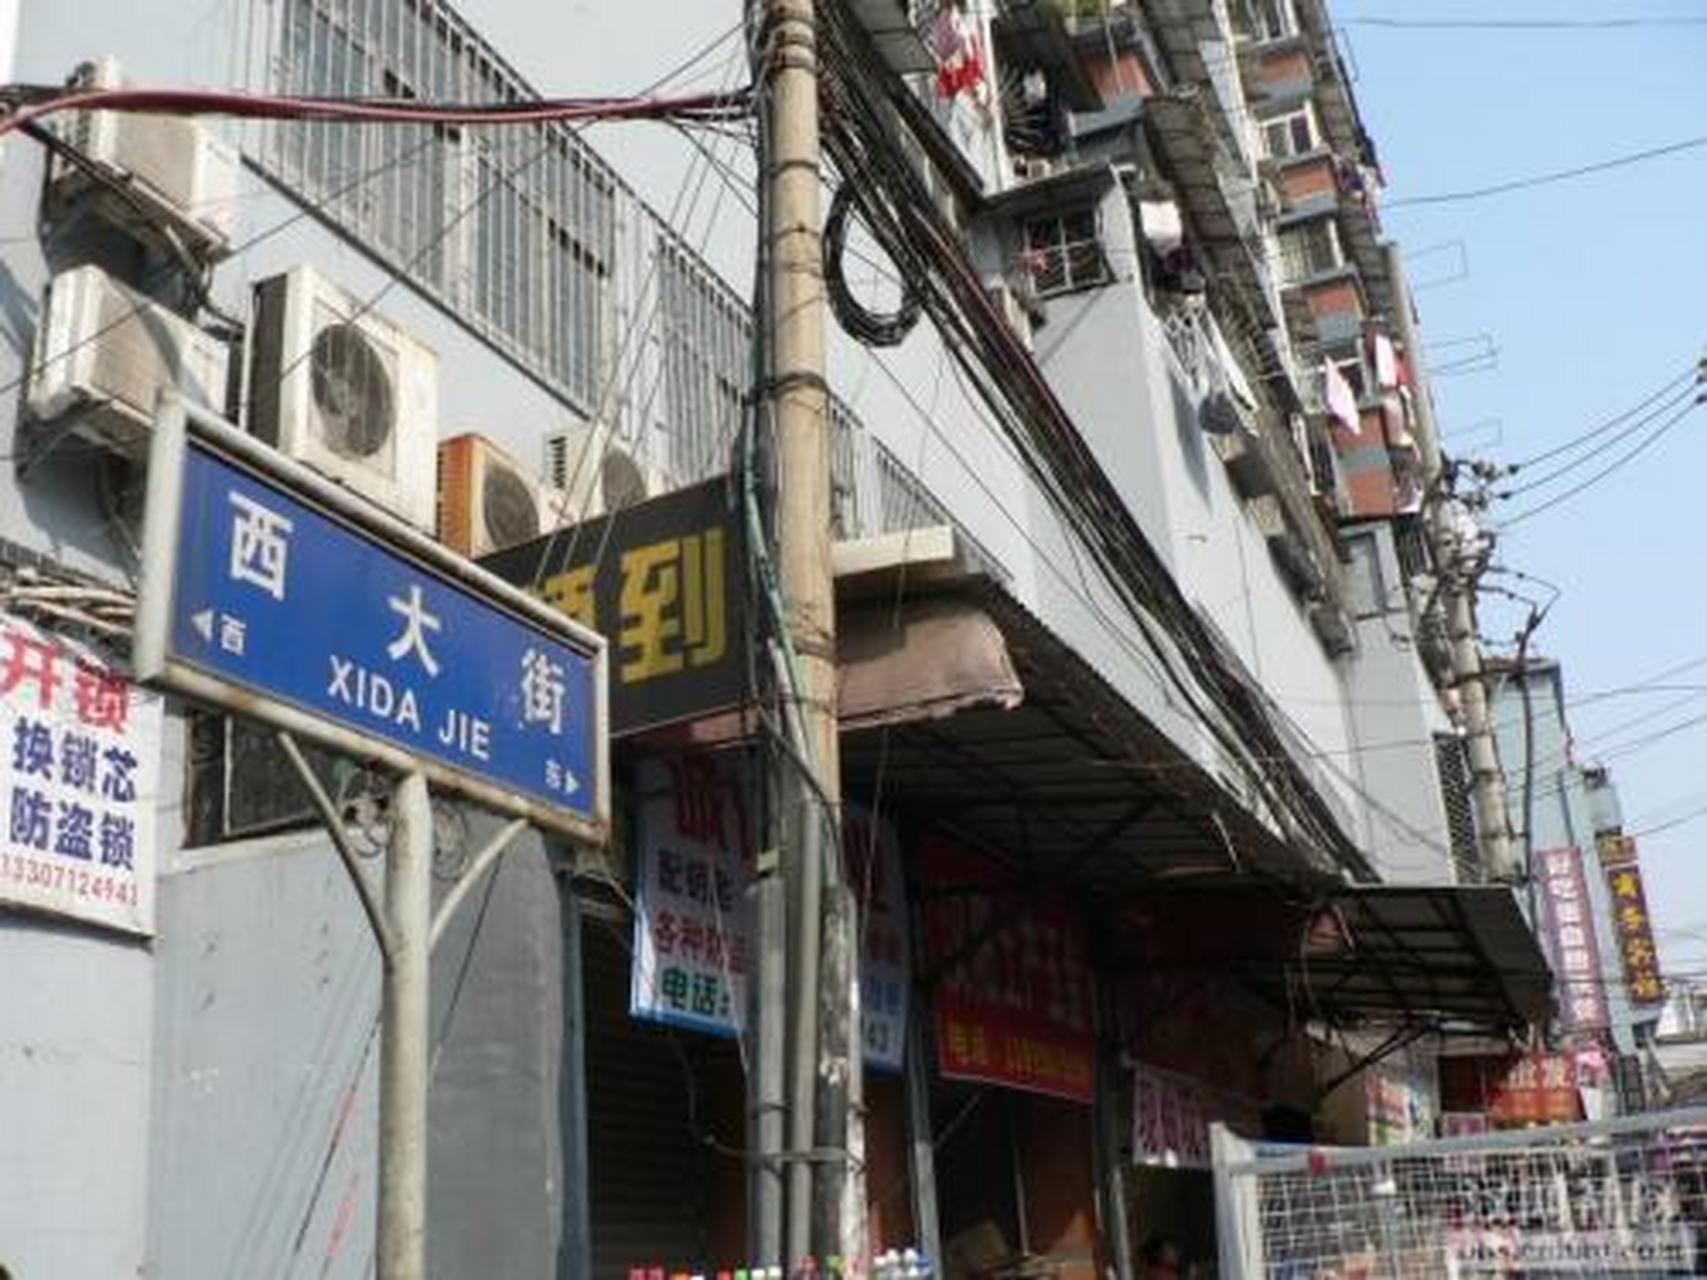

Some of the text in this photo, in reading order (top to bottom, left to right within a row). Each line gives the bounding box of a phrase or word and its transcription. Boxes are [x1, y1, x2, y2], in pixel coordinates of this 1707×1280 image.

[221, 612, 247, 655] 西
[228, 490, 568, 735] 西大街
[328, 654, 491, 762] XIDA JIE
[12, 715, 138, 804] 换锁芯
[9, 786, 135, 871] 防盗锁
